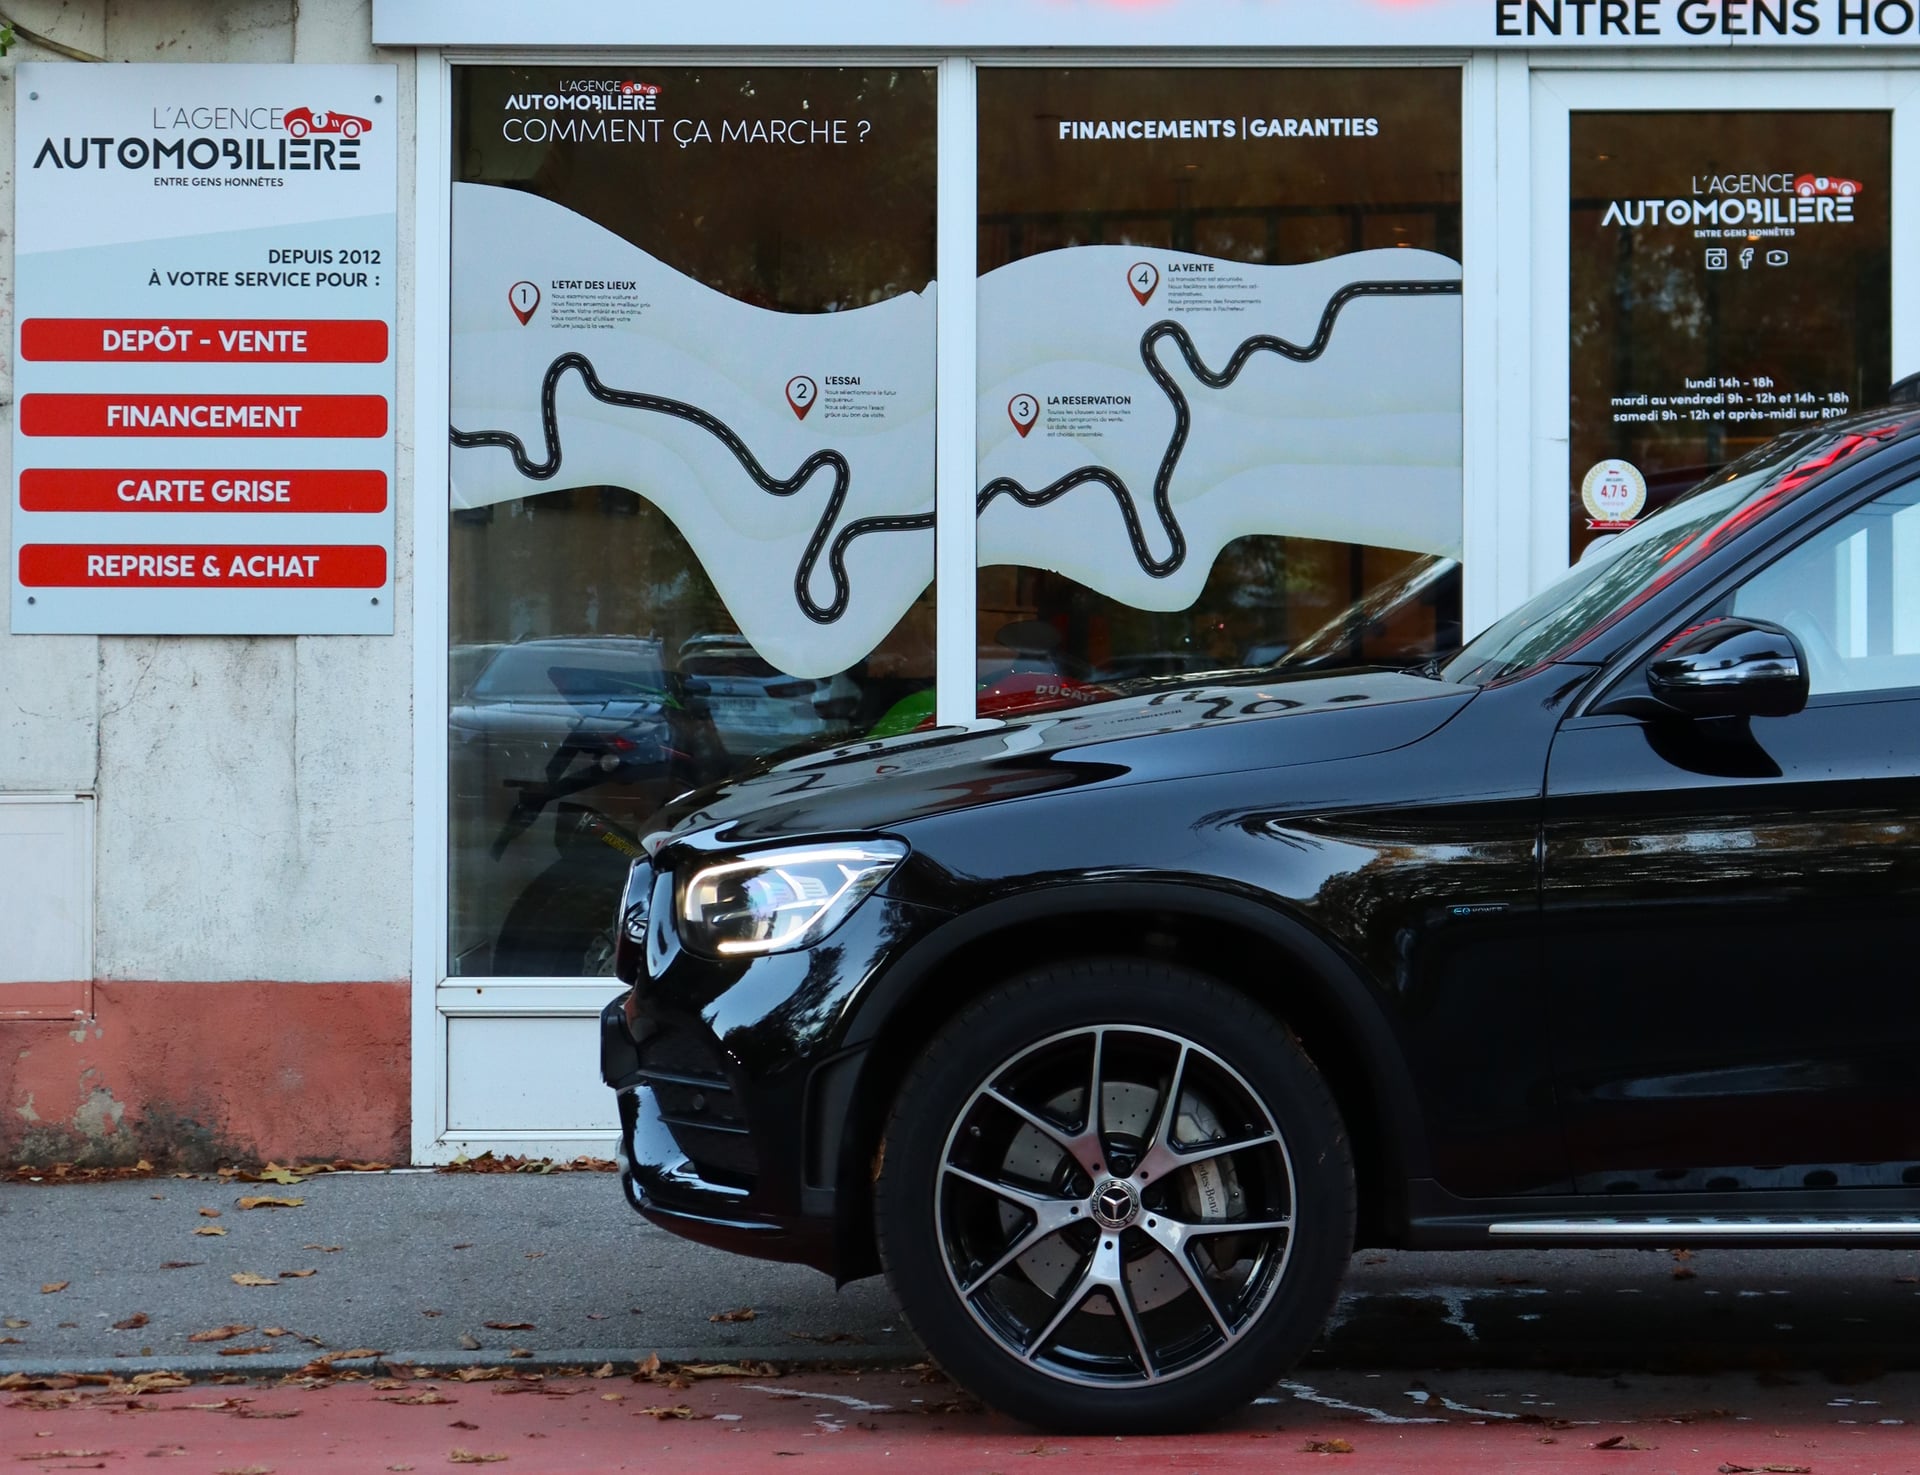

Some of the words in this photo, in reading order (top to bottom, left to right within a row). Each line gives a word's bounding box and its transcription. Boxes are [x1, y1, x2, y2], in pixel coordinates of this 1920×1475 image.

[1497, 0, 1660, 35] ENTRE
[1677, 0, 1820, 35] GENS
[1838, 0, 1920, 35] HO
[560, 80, 621, 93] L'AGENCE
[154, 107, 283, 129] L'AGENCE
[503, 118, 663, 142] COMMENT
[673, 118, 711, 148] ÇA
[721, 120, 847, 144] MARCHE
[858, 120, 870, 143] ?
[1059, 119, 1236, 140] FINANCEMENTS
[1250, 117, 1378, 137] GARANTIES
[154, 178, 189, 186] ENTRE
[192, 178, 222, 186] GENS
[225, 176, 283, 187] HONNÊTES
[1693, 173, 1794, 194] L'AGENCE
[1694, 230, 1721, 238] ENTRE
[1724, 229, 1747, 237] GENS
[1749, 227, 1795, 237] HONNÊTES
[269, 250, 332, 264] DEPUIS
[339, 250, 381, 264] 2012
[1168, 264, 1180, 272] LA
[1184, 264, 1214, 272] VENTE
[149, 269, 161, 286] À
[167, 272, 229, 286] VOTRE
[235, 272, 310, 286] SERVICE
[316, 273, 367, 287] POUR
[1138, 270, 1148, 284] 4
[552, 281, 583, 289] L'ETAT
[585, 281, 604, 289] DES
[607, 281, 636, 290] LIEUX
[522, 289, 526, 304] 1
[103, 326, 192, 352] DEPÔT
[219, 330, 307, 352] VENTE
[825, 376, 861, 385] L'ESSAI
[1685, 378, 1716, 388] lundi
[1720, 378, 1740, 388] 14h
[1753, 377, 1773, 388] 18h
[797, 384, 807, 398] 2
[1048, 396, 1059, 404] LA
[1062, 396, 1131, 405] RESERVATION
[1611, 395, 1648, 406] mardi
[1651, 397, 1667, 405] au
[1670, 394, 1724, 405] vendredi
[1727, 393, 1743, 404] 9h
[1756, 393, 1776, 404] 12h
[1779, 394, 1791, 404] et
[1794, 392, 1815, 404] 14h
[1828, 392, 1849, 403] 18h
[1019, 401, 1029, 417] 3
[1613, 410, 1659, 422] samedi
[1662, 410, 1677, 421] 9h
[1690, 410, 1709, 421] 12h
[1713, 410, 1725, 420] et
[1729, 408, 1797, 422] après-midi
[1800, 411, 1819, 419] sur
[107, 406, 302, 427] FINANCEMENT
[117, 480, 204, 502] CARTE
[212, 481, 290, 502] GRISE
[88, 556, 194, 577] REPRISE
[203, 556, 220, 577] &
[229, 556, 319, 577] ACHAT
